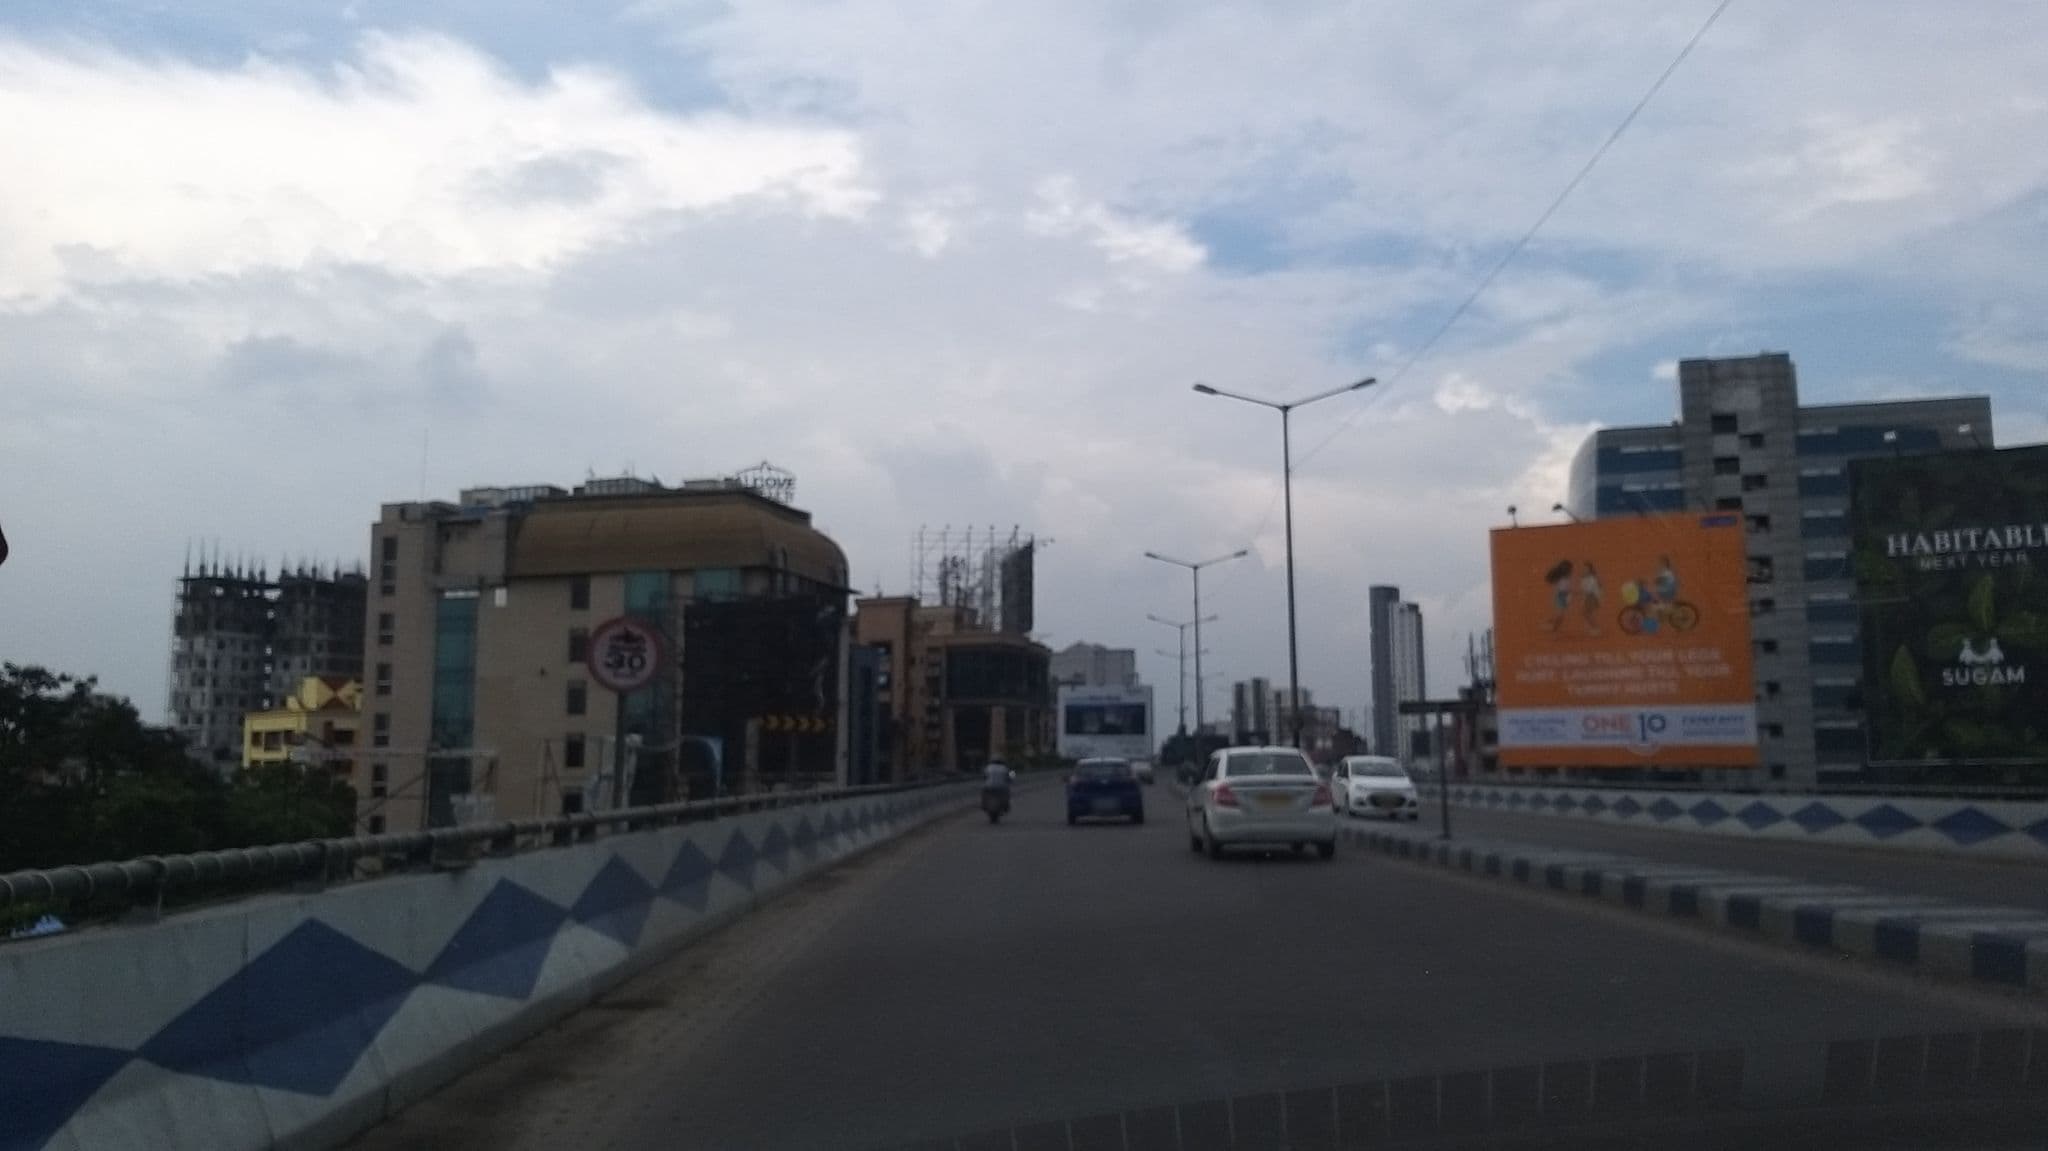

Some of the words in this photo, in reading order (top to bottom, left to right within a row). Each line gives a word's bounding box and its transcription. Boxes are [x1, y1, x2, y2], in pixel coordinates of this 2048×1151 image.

[1976, 550, 2028, 567] YEAR
[1942, 664, 2026, 687] SUGAM
[1582, 714, 1632, 732] ONE
